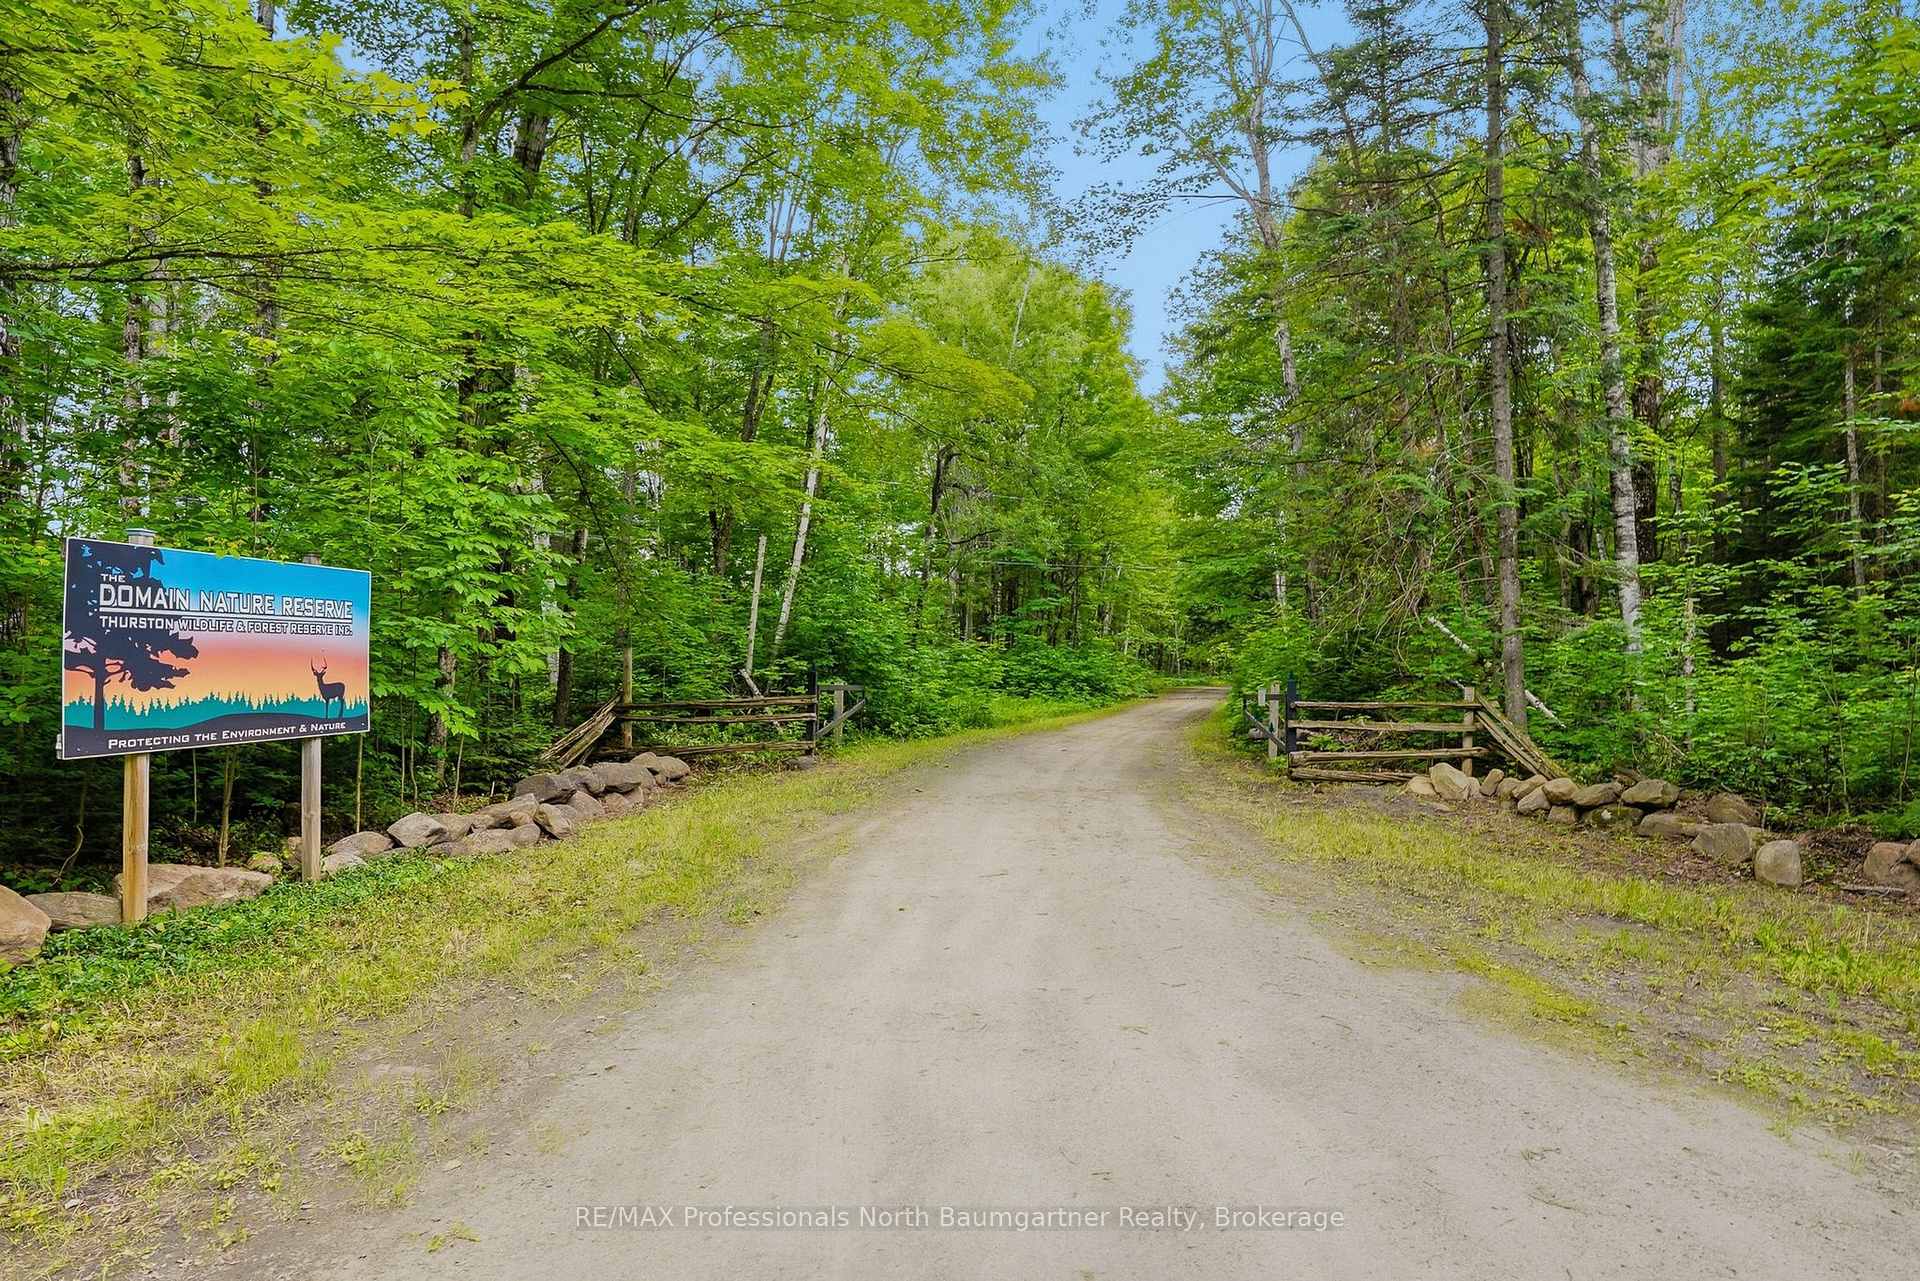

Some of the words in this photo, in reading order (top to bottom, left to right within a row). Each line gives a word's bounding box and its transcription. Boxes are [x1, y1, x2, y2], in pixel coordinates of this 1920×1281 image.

[100, 573, 126, 583] THE
[99, 583, 190, 611] DOMAIN
[200, 590, 275, 615] NATURE
[282, 597, 353, 619] RESERVE
[99, 615, 176, 630] THURSTON
[178, 618, 233, 633] WILDLIFE
[236, 621, 247, 633] &
[248, 622, 288, 634] FOREST
[290, 624, 333, 635] RESERVE
[299, 723, 308, 733] &
